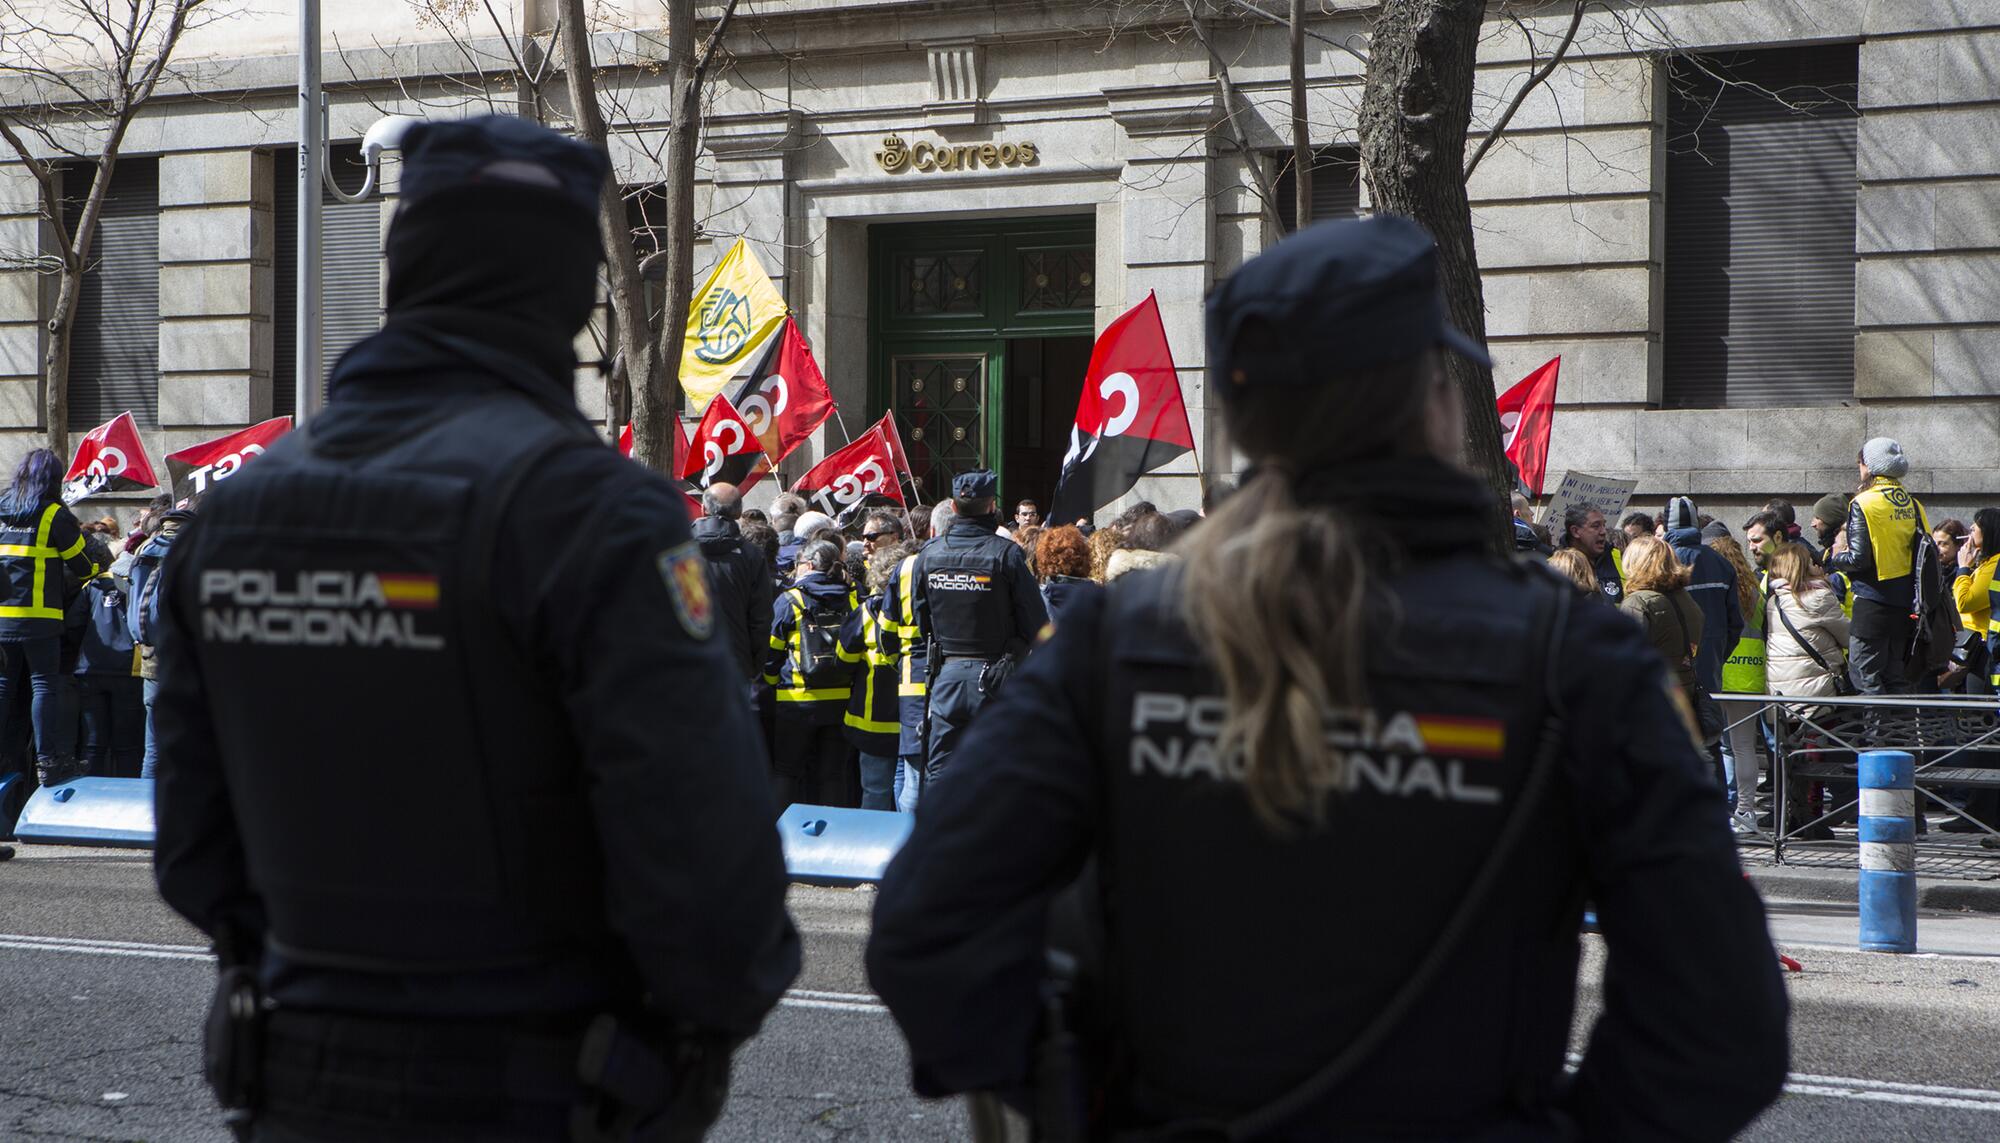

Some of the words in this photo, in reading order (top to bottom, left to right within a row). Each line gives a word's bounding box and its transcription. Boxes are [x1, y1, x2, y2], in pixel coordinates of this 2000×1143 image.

[911, 139, 1037, 171] Correos
[202, 569, 387, 608] POLICIA
[928, 573, 977, 583] POLICIA
[928, 581, 992, 591] NACIONAL
[203, 608, 445, 649] NACIONAL
[1131, 692, 1426, 752] POCIA
